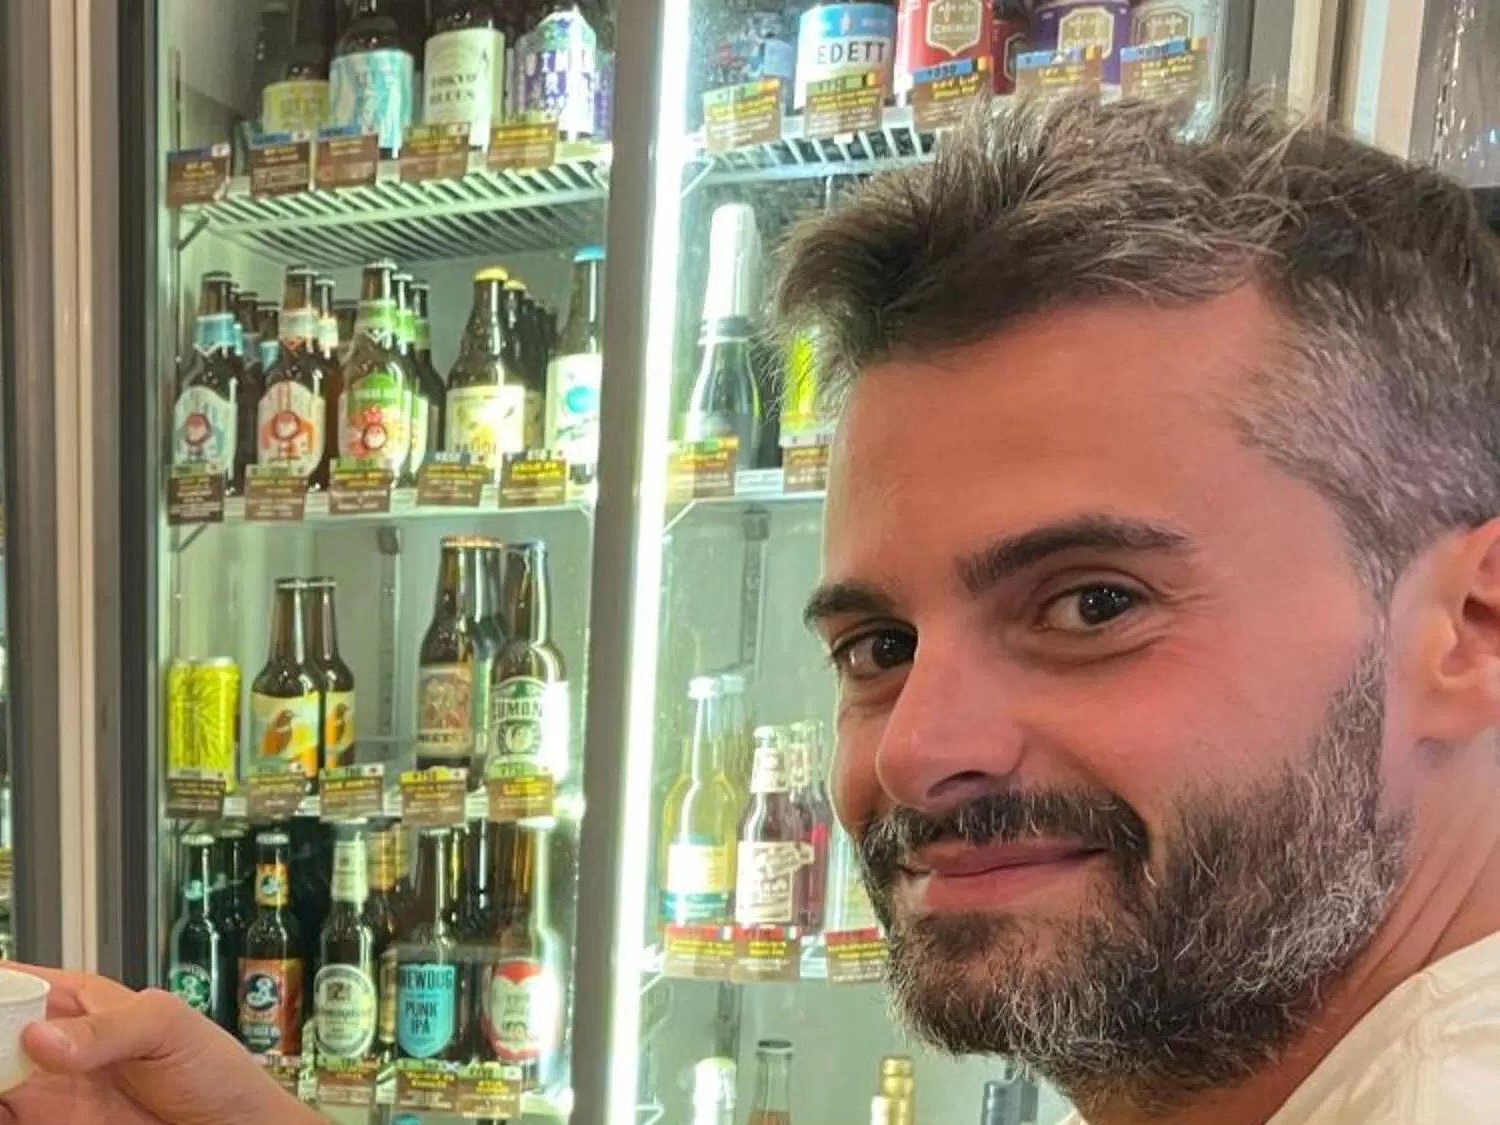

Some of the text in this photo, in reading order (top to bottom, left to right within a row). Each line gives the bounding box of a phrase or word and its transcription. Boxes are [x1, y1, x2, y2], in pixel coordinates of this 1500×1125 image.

[816, 41, 887, 65] EDETT
[399, 969, 454, 990] REWDOG
[406, 1001, 437, 1018] PUNK
[411, 1018, 431, 1035] IPA
